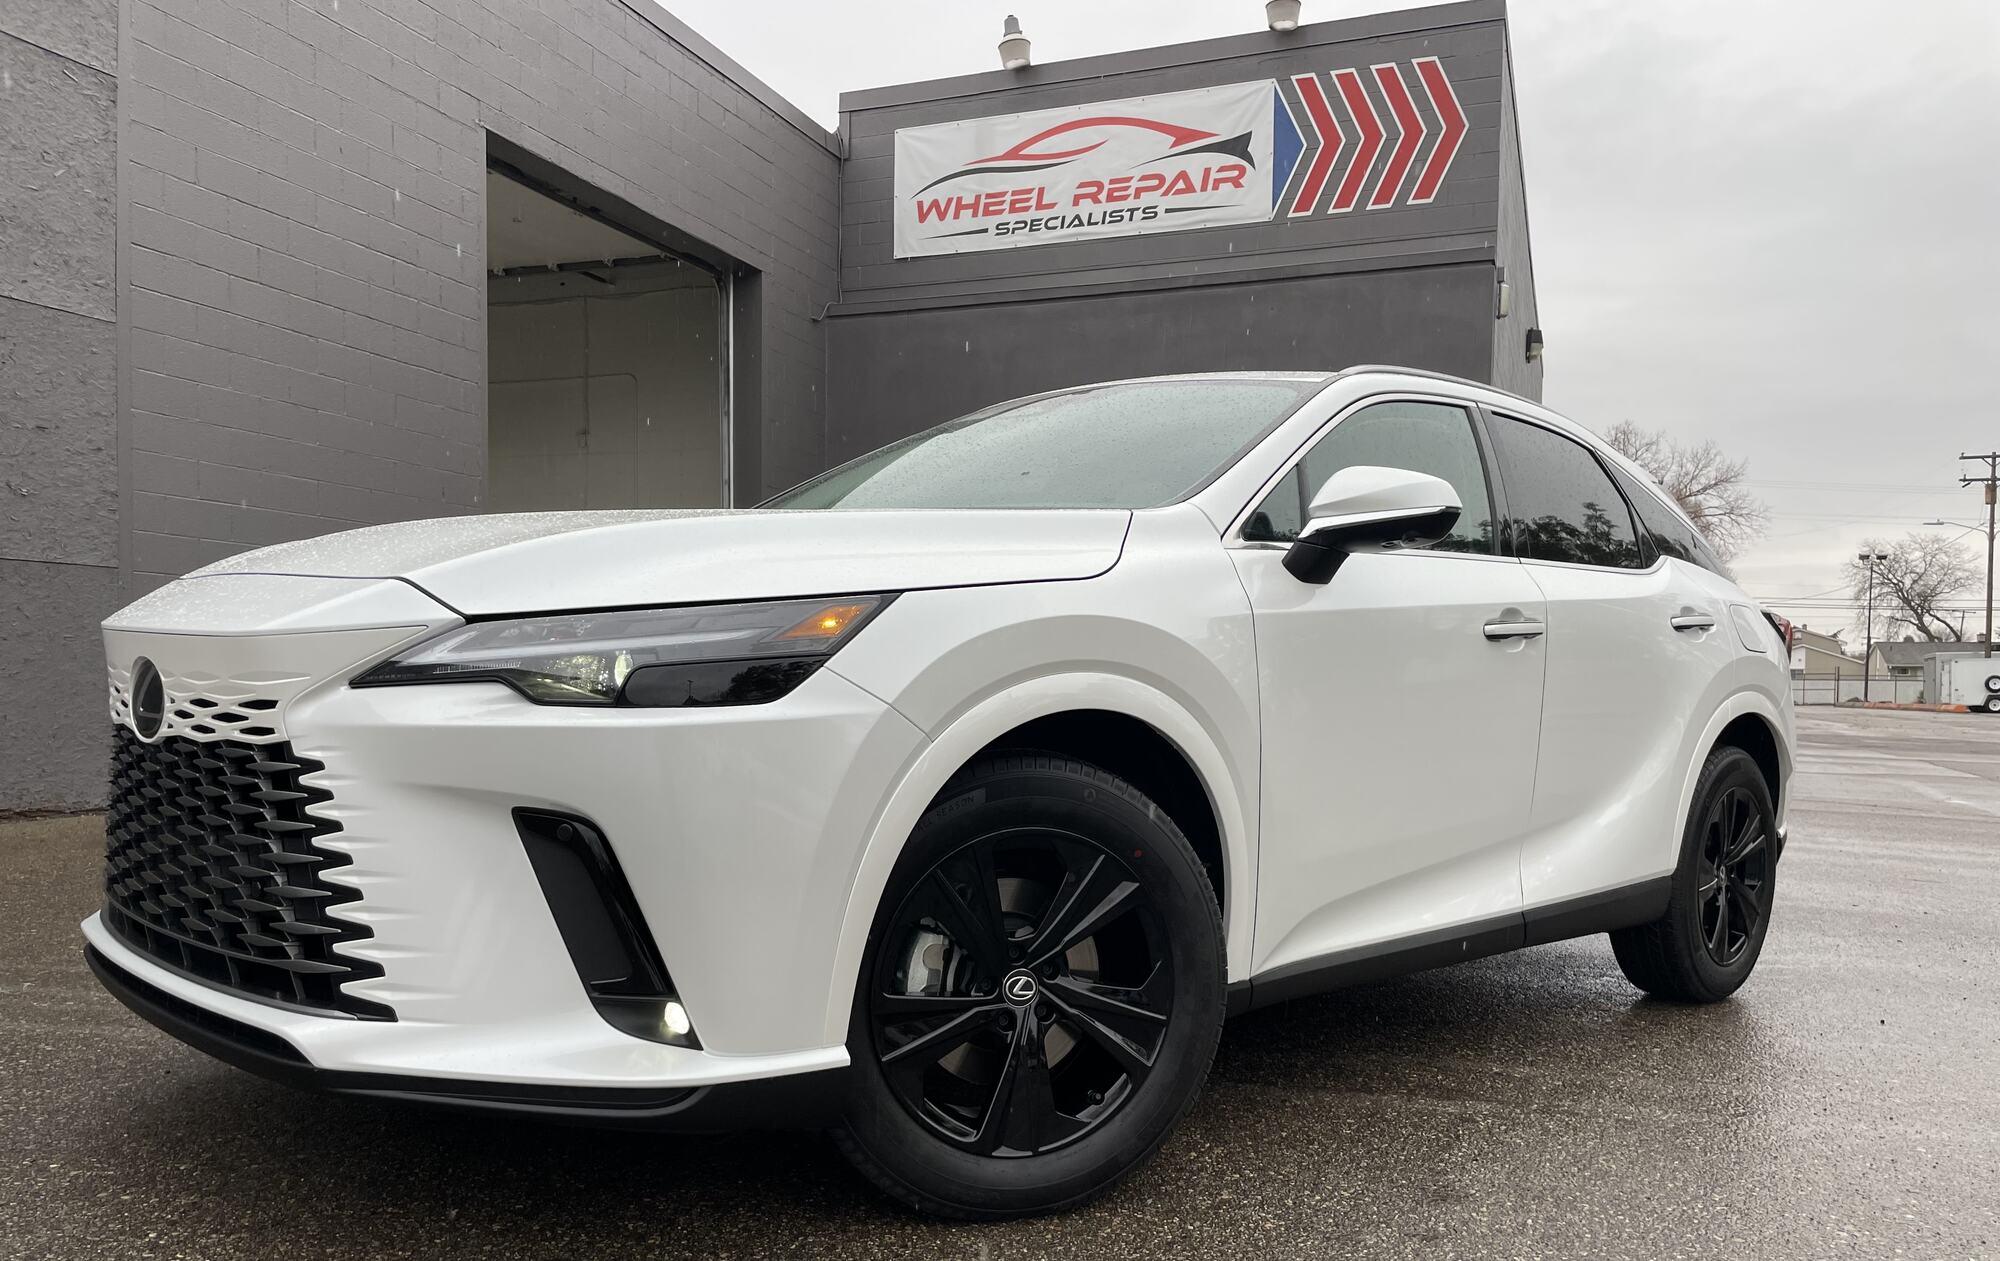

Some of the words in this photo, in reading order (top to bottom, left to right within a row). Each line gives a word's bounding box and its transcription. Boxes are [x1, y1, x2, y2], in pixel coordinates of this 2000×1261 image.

[916, 187, 1058, 224] WHEEL
[1072, 164, 1247, 207] REPAIR
[994, 205, 1159, 236] SPECIALISTS
